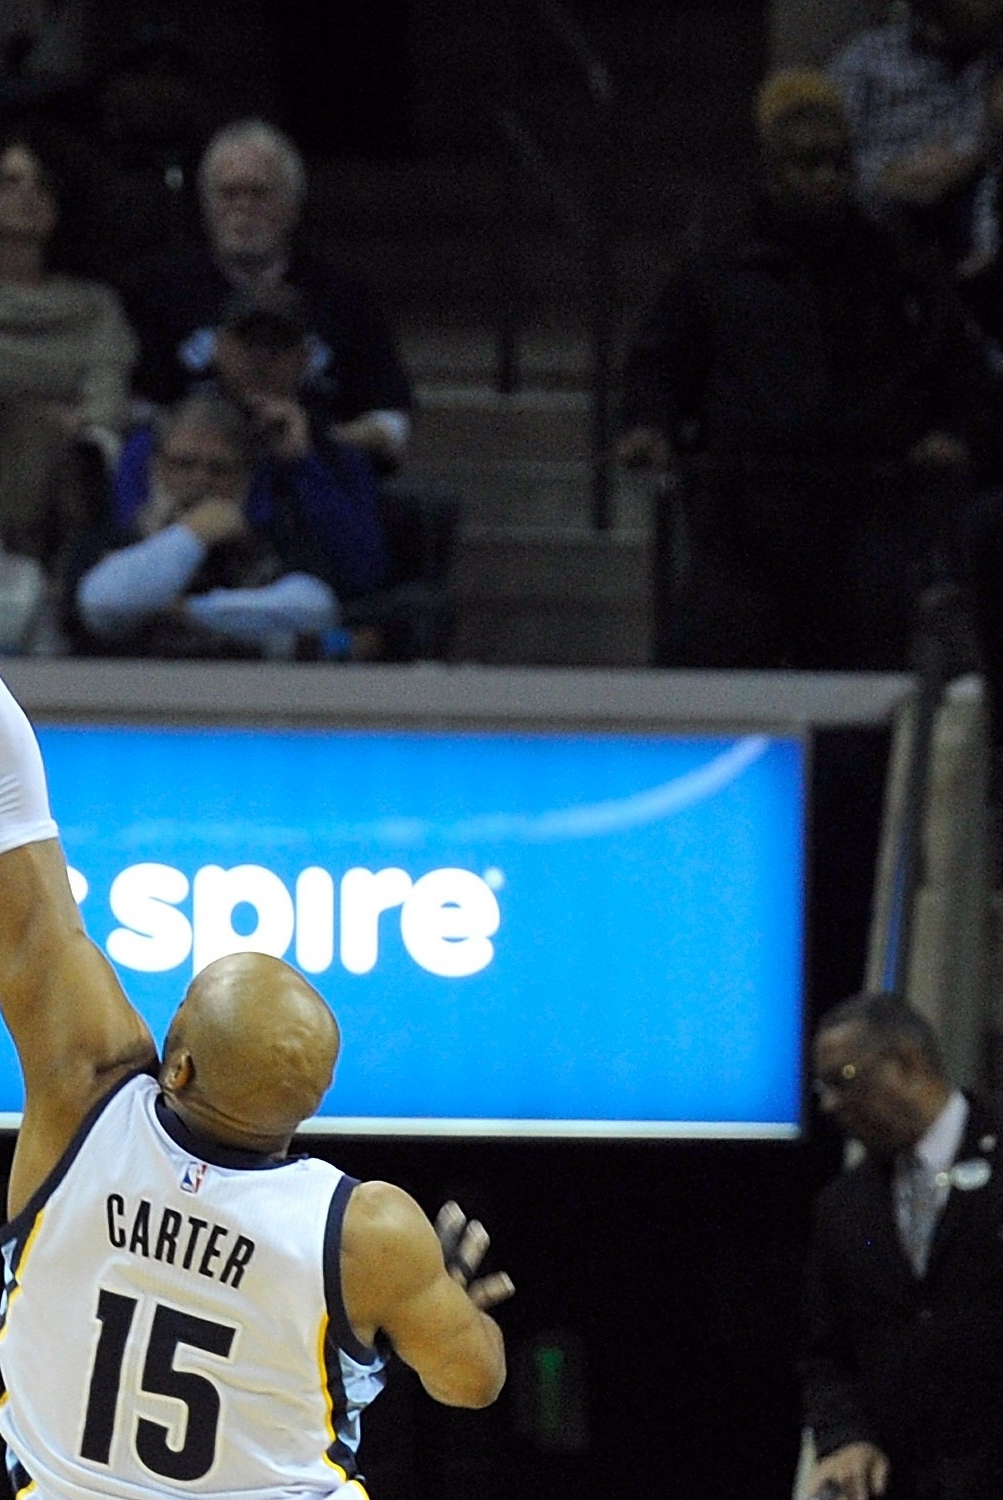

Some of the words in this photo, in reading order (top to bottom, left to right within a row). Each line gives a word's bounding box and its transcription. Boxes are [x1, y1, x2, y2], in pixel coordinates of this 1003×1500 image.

[105, 862, 504, 978] spire
[106, 1193, 255, 1289] CARTER
[80, 1287, 237, 1482] 15
